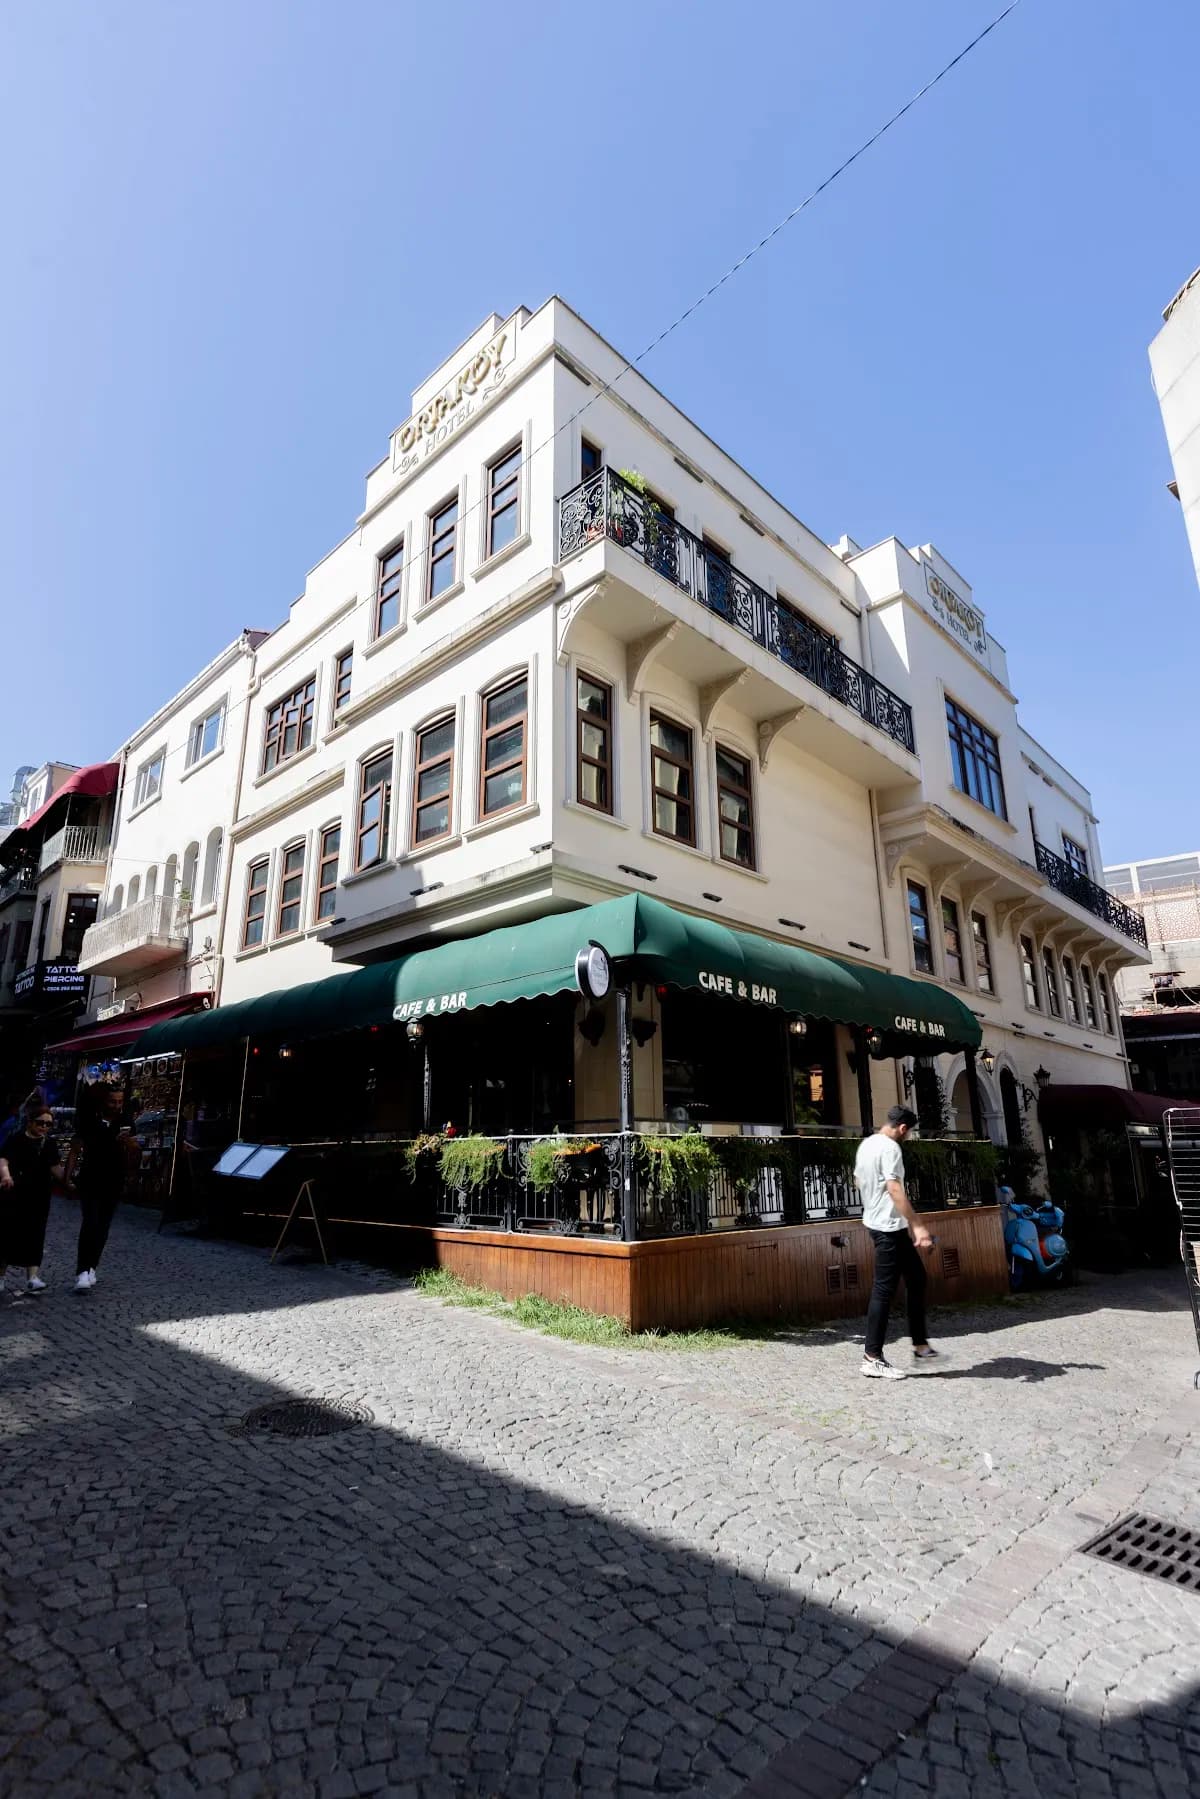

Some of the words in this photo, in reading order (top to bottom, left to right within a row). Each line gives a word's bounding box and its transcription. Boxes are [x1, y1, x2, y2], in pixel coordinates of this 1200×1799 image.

[424, 400, 475, 457] HOTEL
[43, 975, 85, 983] PIERCING
[45, 965, 79, 974] TATTO
[698, 971, 733, 994] CAFE
[737, 980, 748, 998] &
[751, 983, 777, 1005] BAR
[392, 1000, 424, 1021] CAFE
[425, 998, 436, 1013] &
[439, 991, 467, 1011] BAR
[894, 1015, 917, 1032] CAFE
[919, 1020, 927, 1034] &
[927, 1022, 946, 1038] BAR
